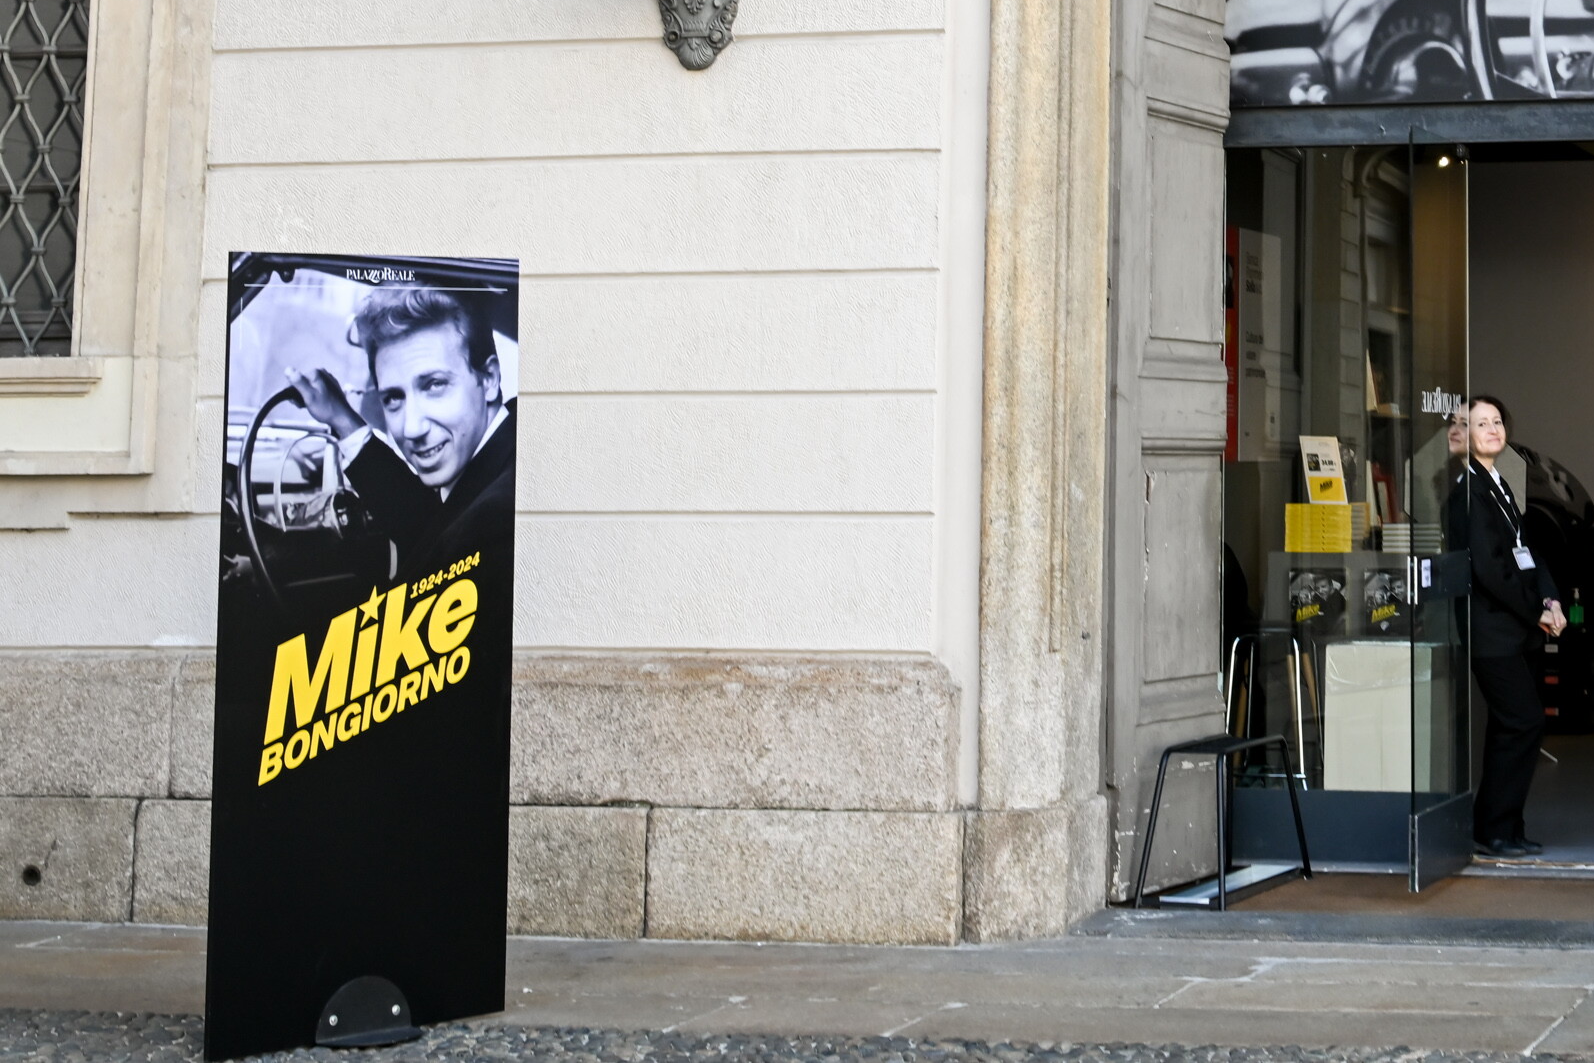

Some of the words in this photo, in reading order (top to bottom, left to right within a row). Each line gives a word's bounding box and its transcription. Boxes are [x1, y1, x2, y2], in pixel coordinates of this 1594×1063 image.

[410, 551, 481, 599] 1924-2024
[257, 646, 471, 787] BONGIORNO
[263, 578, 479, 746] Mike
